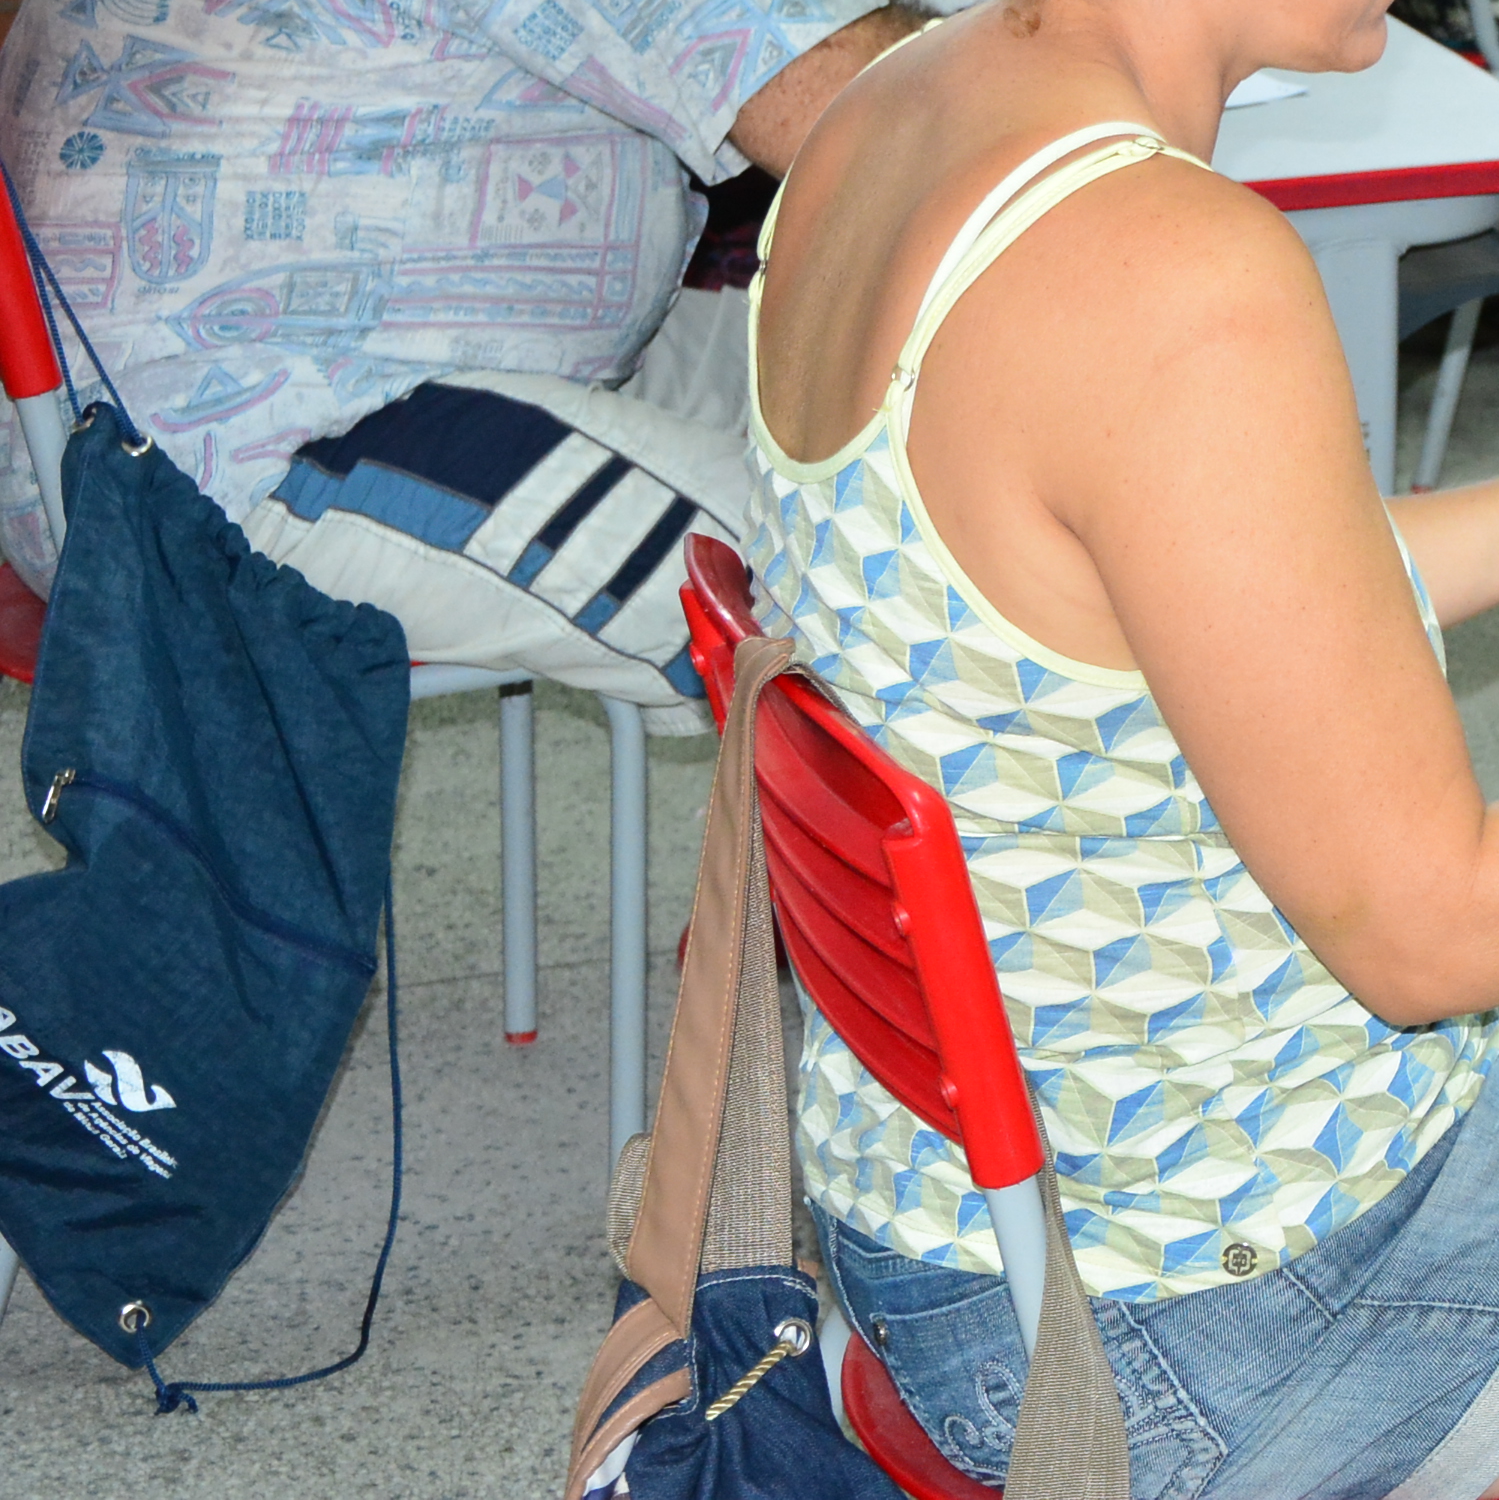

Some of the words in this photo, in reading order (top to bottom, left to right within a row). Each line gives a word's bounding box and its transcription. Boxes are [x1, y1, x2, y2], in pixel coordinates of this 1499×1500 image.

[63, 1101, 76, 1112] de
[91, 1102, 141, 1141] Associação
[78, 1102, 90, 1112] de
[88, 1112, 128, 1145] Agências
[127, 1144, 140, 1155] de
